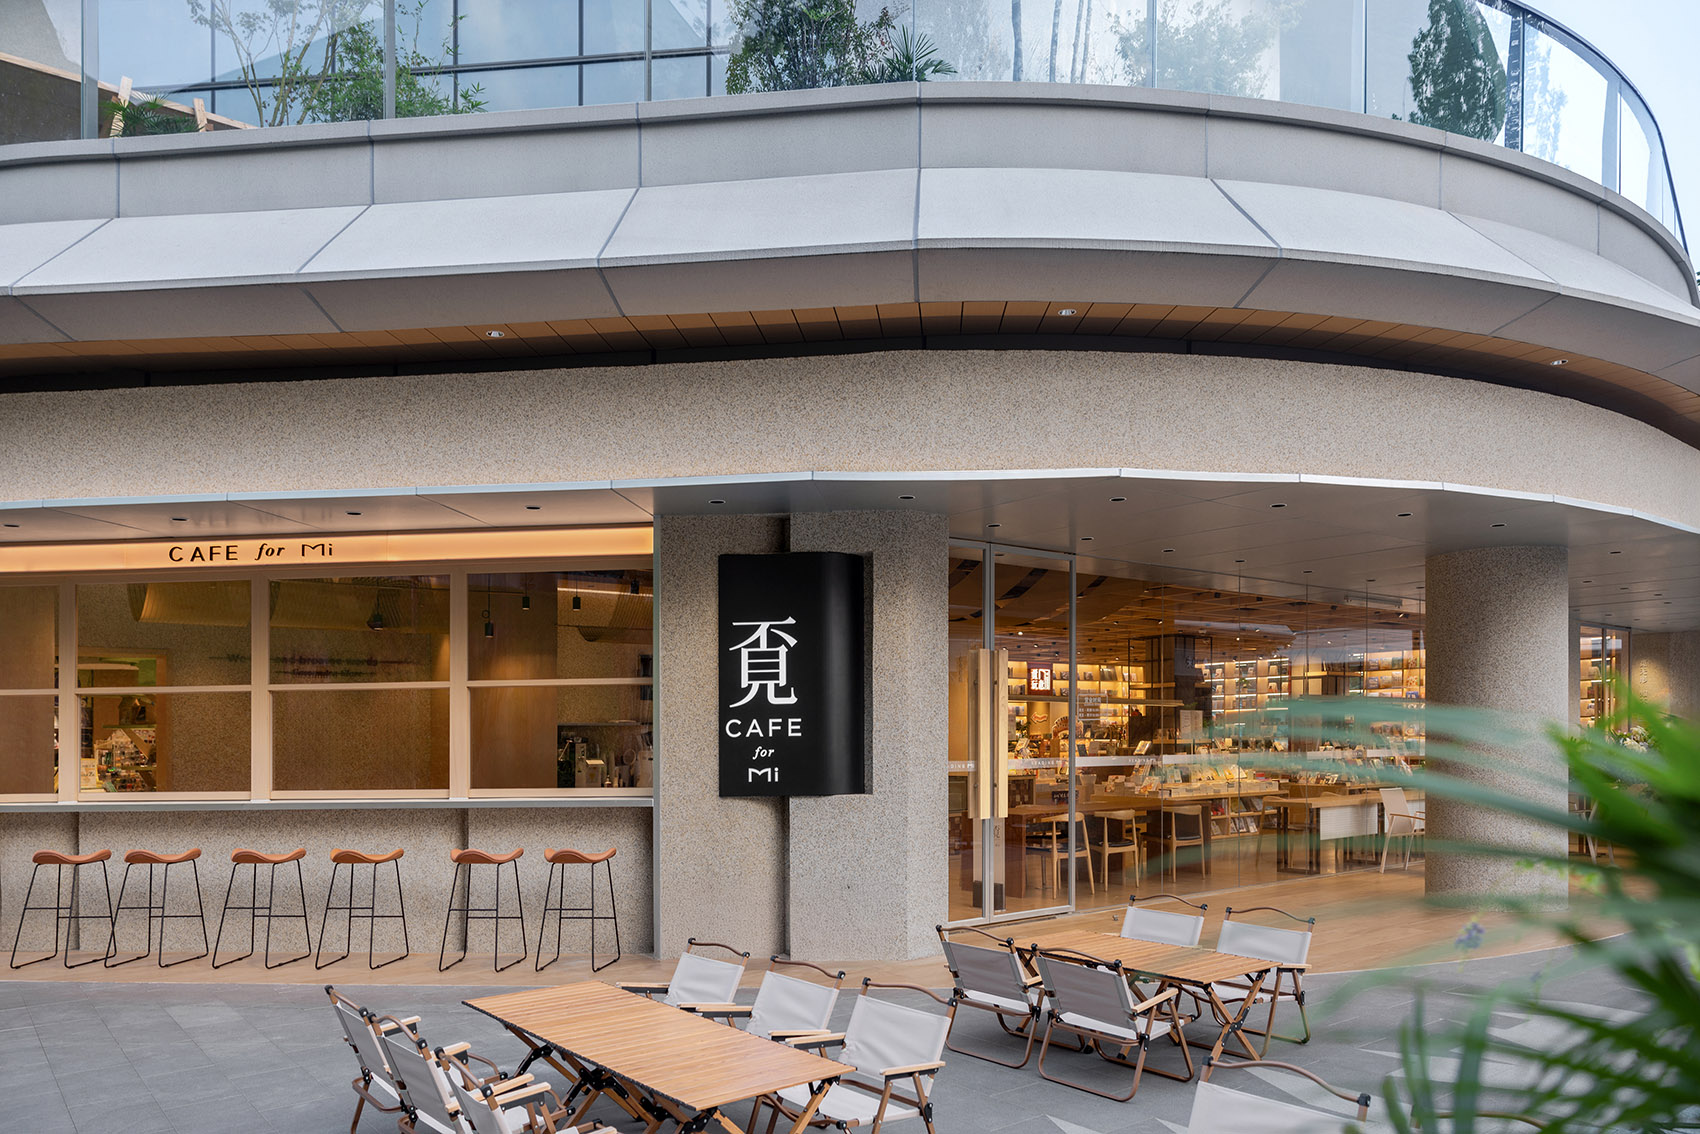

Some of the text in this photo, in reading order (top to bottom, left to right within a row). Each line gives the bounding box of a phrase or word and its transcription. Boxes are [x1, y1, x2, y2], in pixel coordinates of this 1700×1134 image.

[169, 542, 333, 562] CAFE for Mi
[725, 718, 802, 738] CAFE
[752, 746, 775, 760] for
[748, 767, 779, 783] Mi
